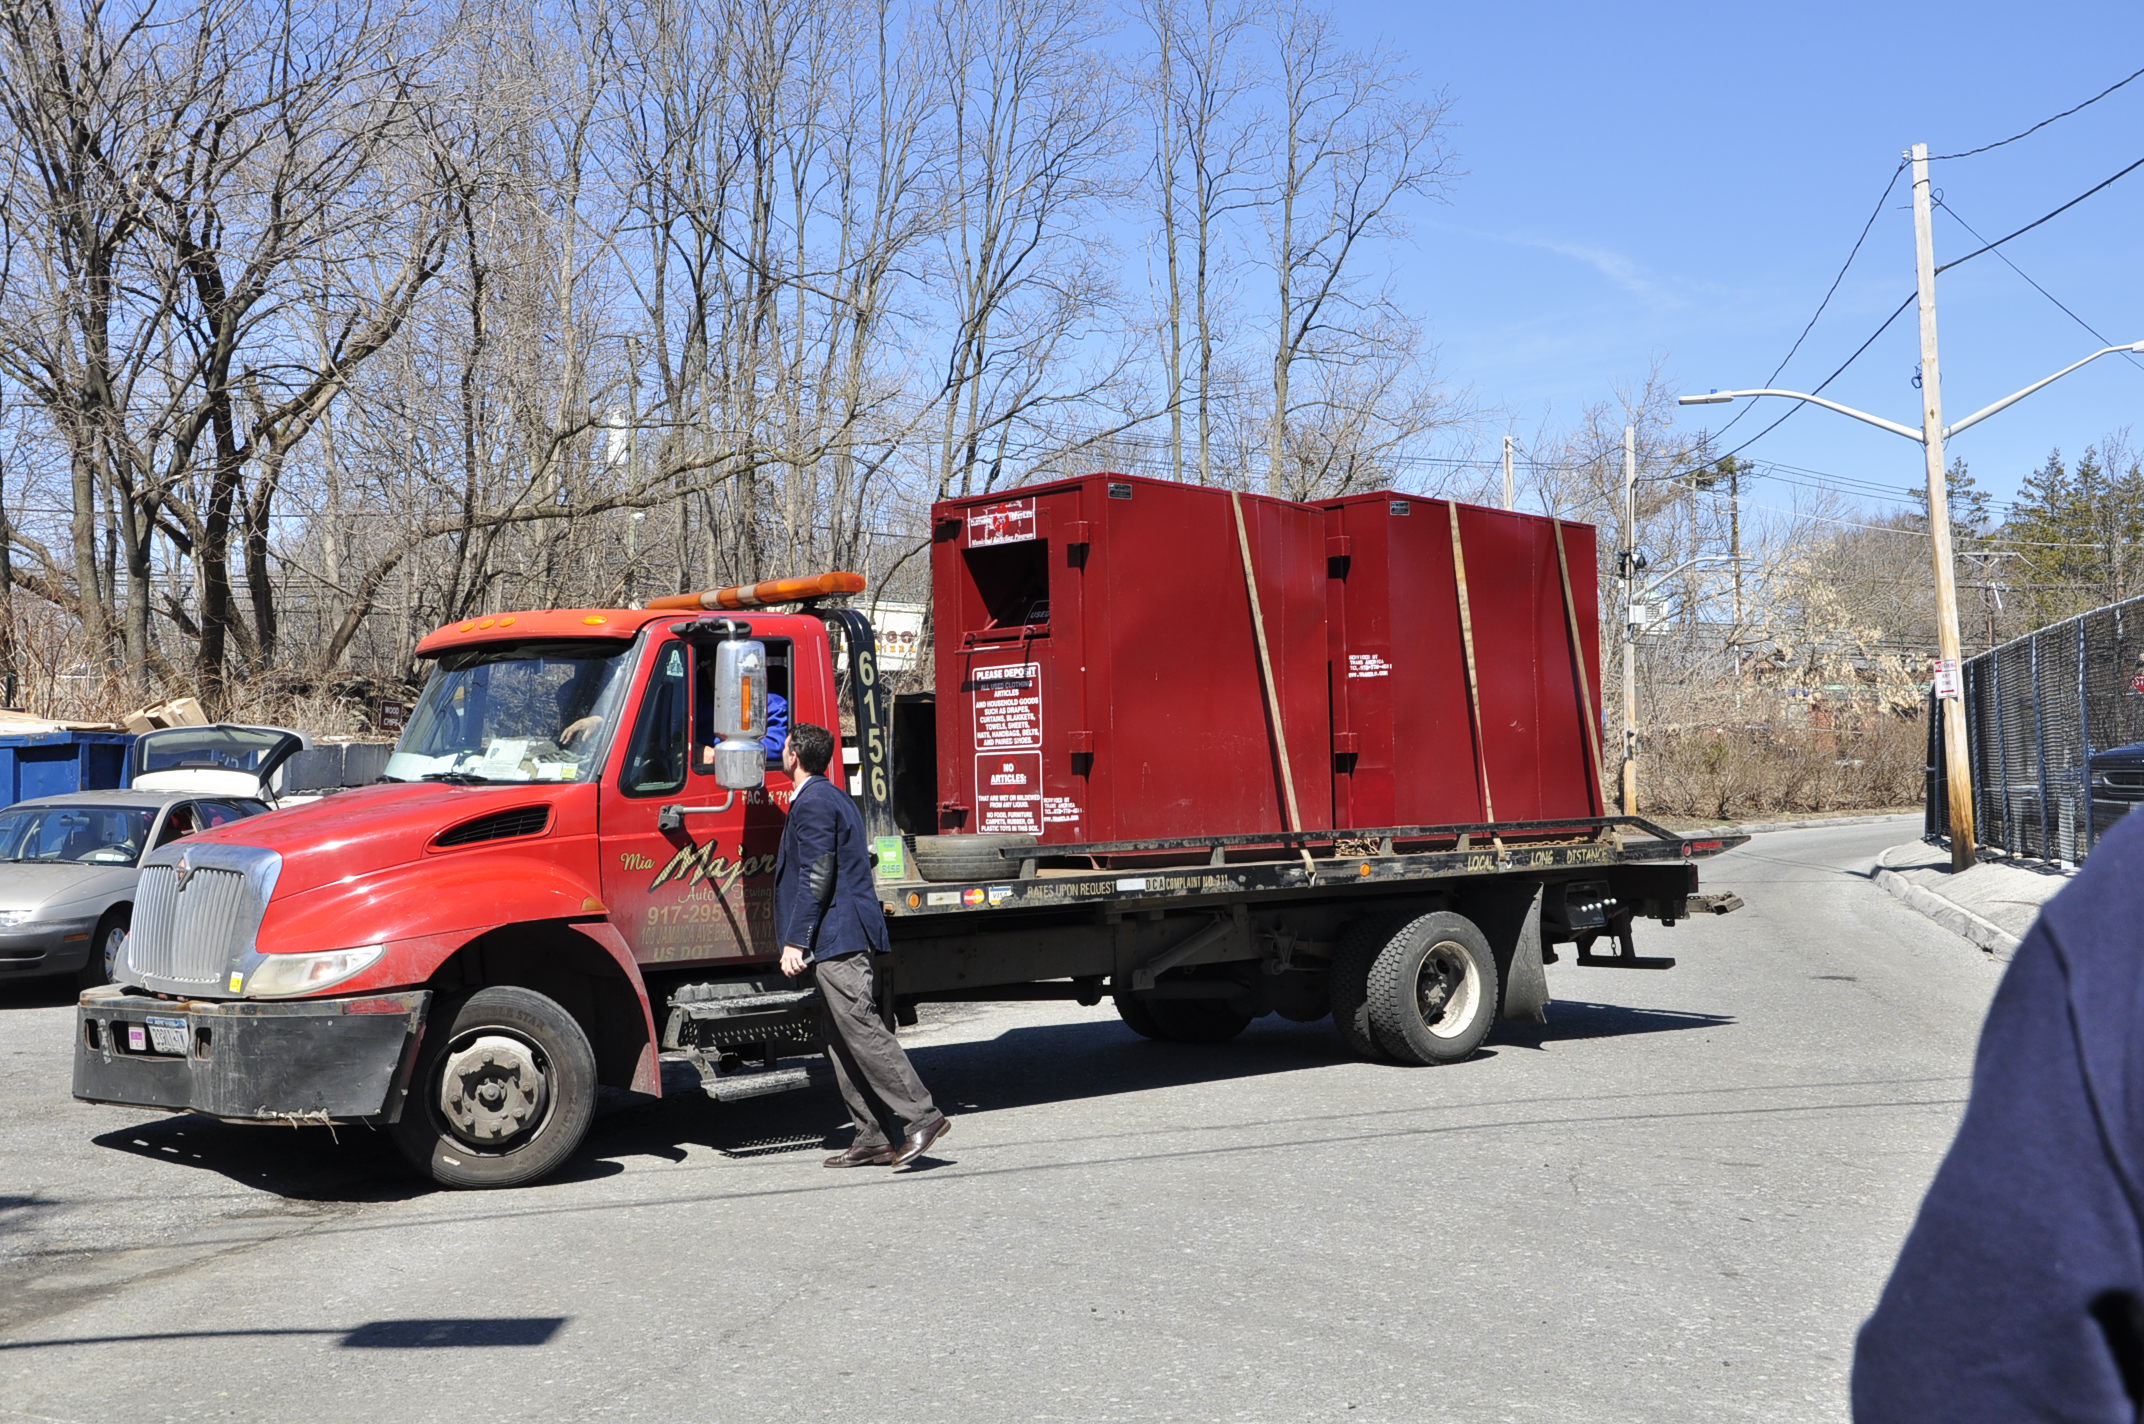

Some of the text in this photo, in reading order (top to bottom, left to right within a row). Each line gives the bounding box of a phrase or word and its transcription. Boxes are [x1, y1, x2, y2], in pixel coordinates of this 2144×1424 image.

[976, 666, 1036, 680] PLEASE DEPOSIT
[1005, 680, 1032, 689] CLOTHING
[994, 689, 1019, 697] ARTICLES
[987, 699, 1018, 707] HOUSEHOLD
[1019, 697, 1039, 705] GOODS
[858, 650, 887, 802] 6156
[1003, 763, 1014, 772] NO
[990, 774, 1027, 785] ARTICLES:
[742, 790, 764, 806] FAC.
[1467, 847, 1608, 872] LOCAL LONG DISTANCE
[620, 839, 776, 900] Mia Major
[678, 884, 772, 904] Auto Towing
[992, 891, 1008, 899] VISA
[1027, 885, 1053, 899] RATES
[1055, 883, 1078, 897] UPON
[1079, 880, 1116, 896] REQUEST
[1165, 876, 1200, 890] COMPLAINT
[696, 922, 714, 943] AVE
[653, 946, 675, 962] US
[679, 945, 714, 960] DOT
